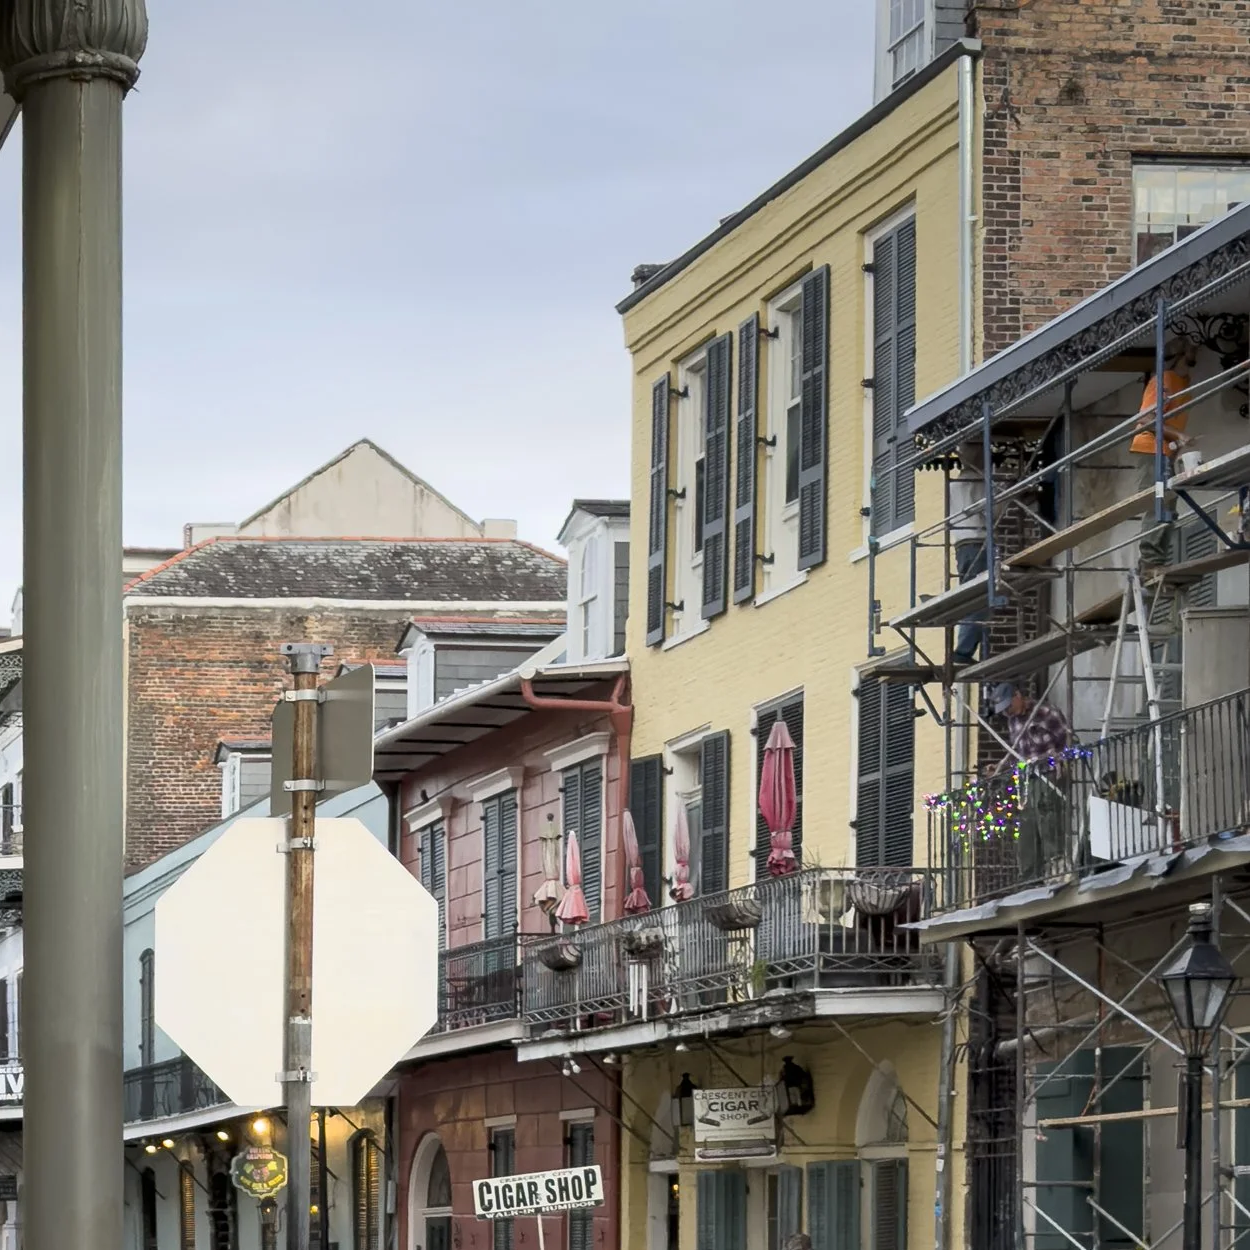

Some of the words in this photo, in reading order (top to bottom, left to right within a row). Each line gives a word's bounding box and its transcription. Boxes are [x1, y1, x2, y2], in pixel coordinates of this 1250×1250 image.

[695, 1091, 748, 1101] CRESCENT
[750, 1090, 772, 1099] CITY
[707, 1100, 759, 1113] CIGAR
[719, 1112, 751, 1121] SHOP
[478, 1181, 541, 1212] CIGAR
[545, 1168, 597, 1204] SHOP
[485, 1208, 535, 1219] WALK-IN
[541, 1200, 596, 1213] HUMIDOR
